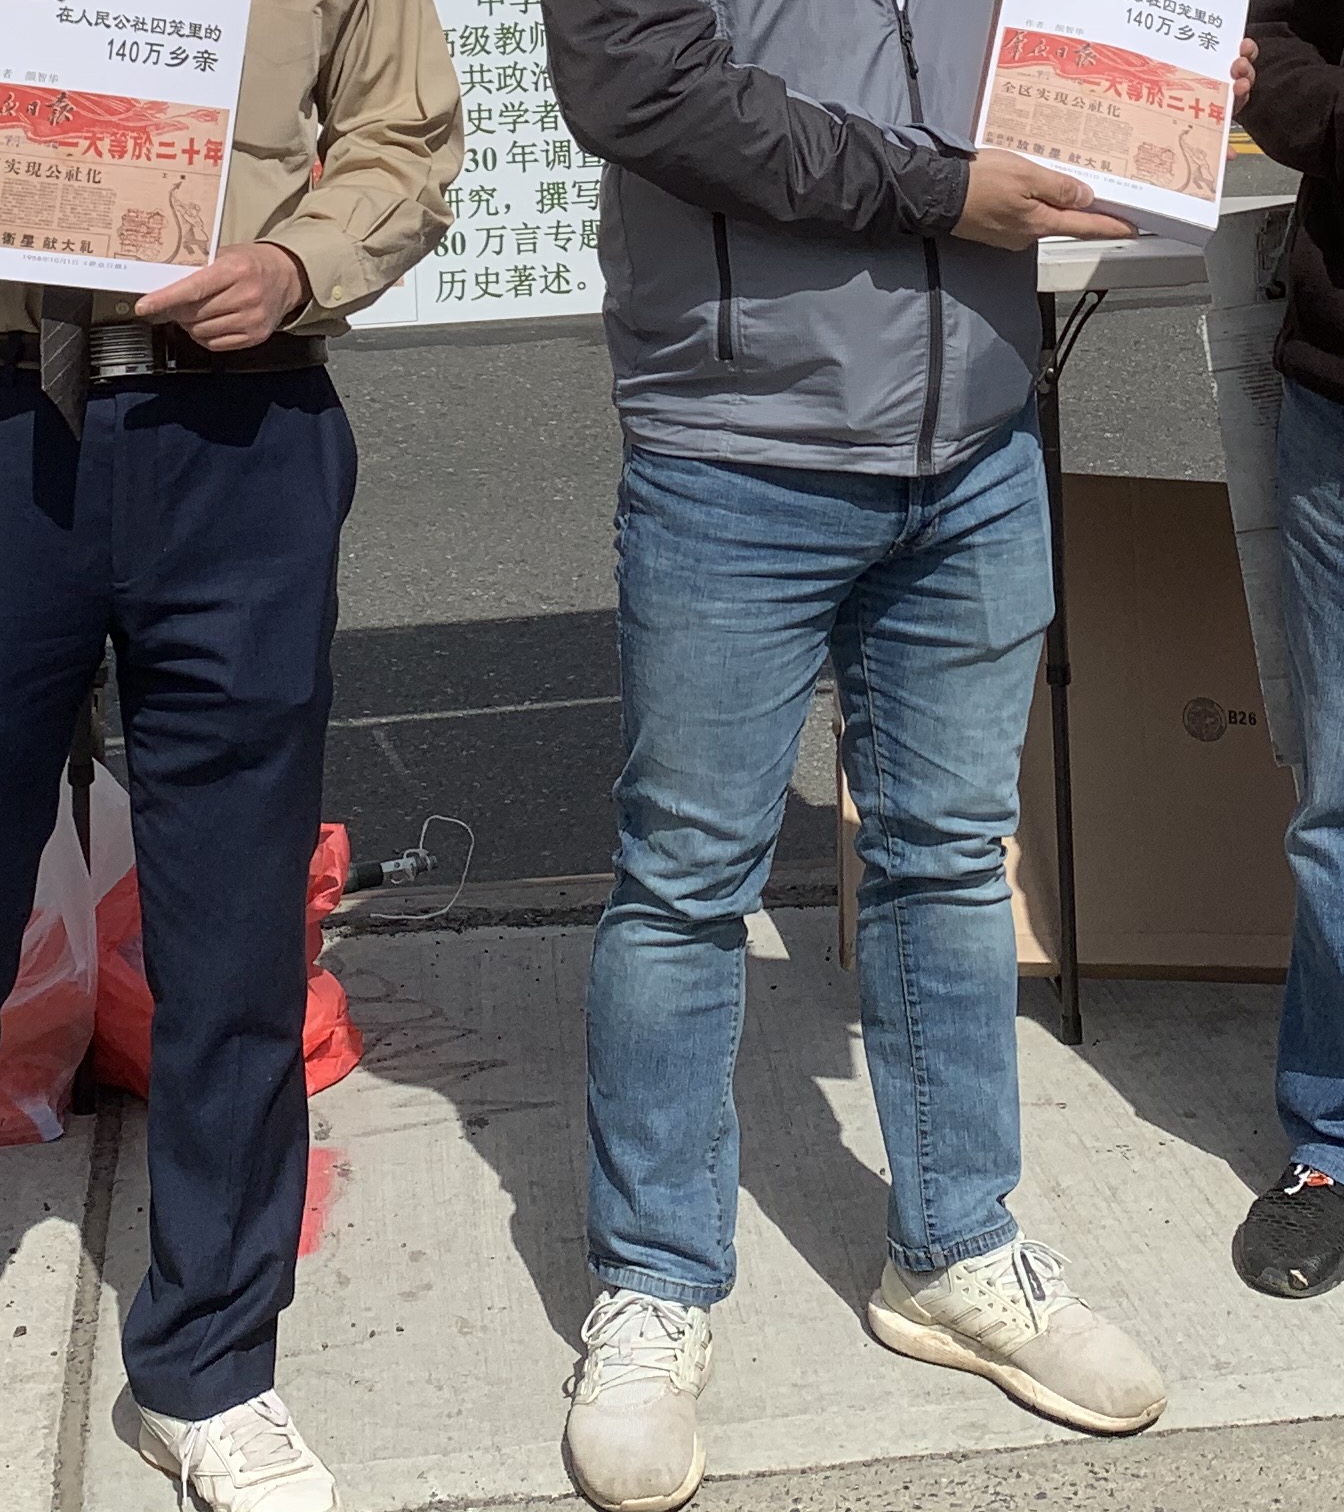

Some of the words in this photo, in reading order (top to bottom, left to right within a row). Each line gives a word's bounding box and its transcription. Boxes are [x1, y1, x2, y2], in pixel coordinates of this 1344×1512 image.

[56, 5, 222, 42] 在人民公社囚笼里的
[1126, 8, 1220, 52] 140万乡亲
[106, 38, 219, 73] 140万乡亲
[464, 100, 561, 137] 史学者
[435, 263, 587, 304] 历史著述。
